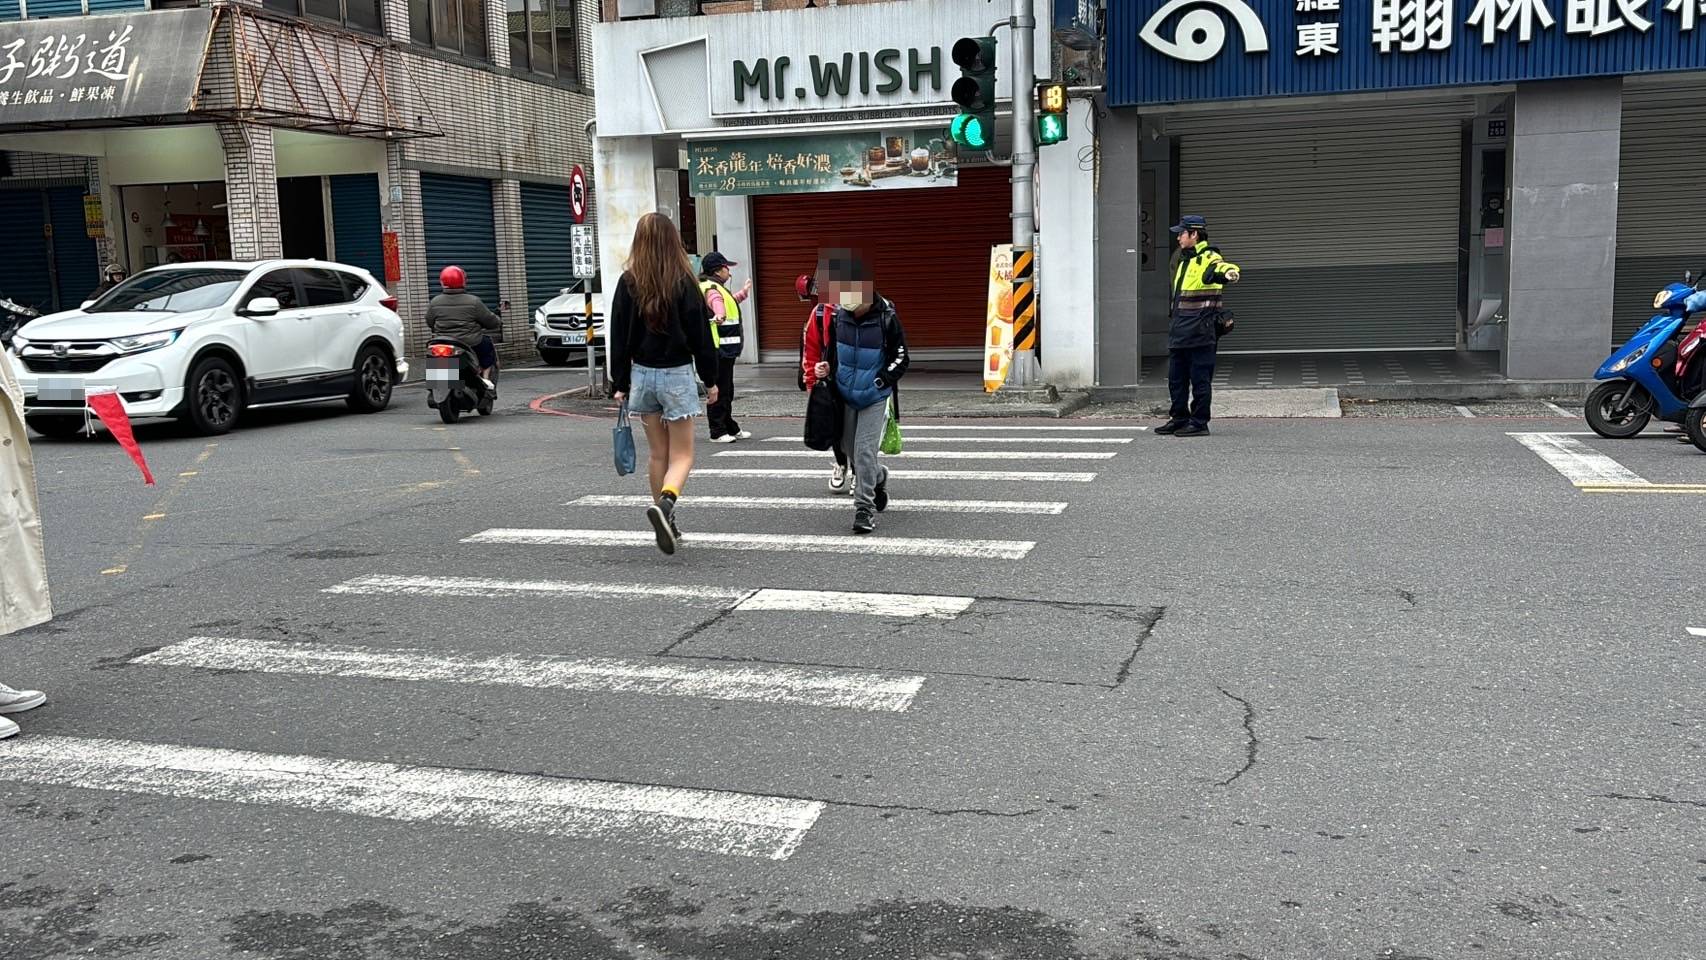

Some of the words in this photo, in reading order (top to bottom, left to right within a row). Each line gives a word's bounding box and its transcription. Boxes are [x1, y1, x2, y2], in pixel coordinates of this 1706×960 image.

[733, 46, 941, 102] Mr.WISH
[696, 152, 763, 176] 茶香龍年
[766, 152, 833, 176] 焙香好濃
[719, 176, 736, 192] 28
